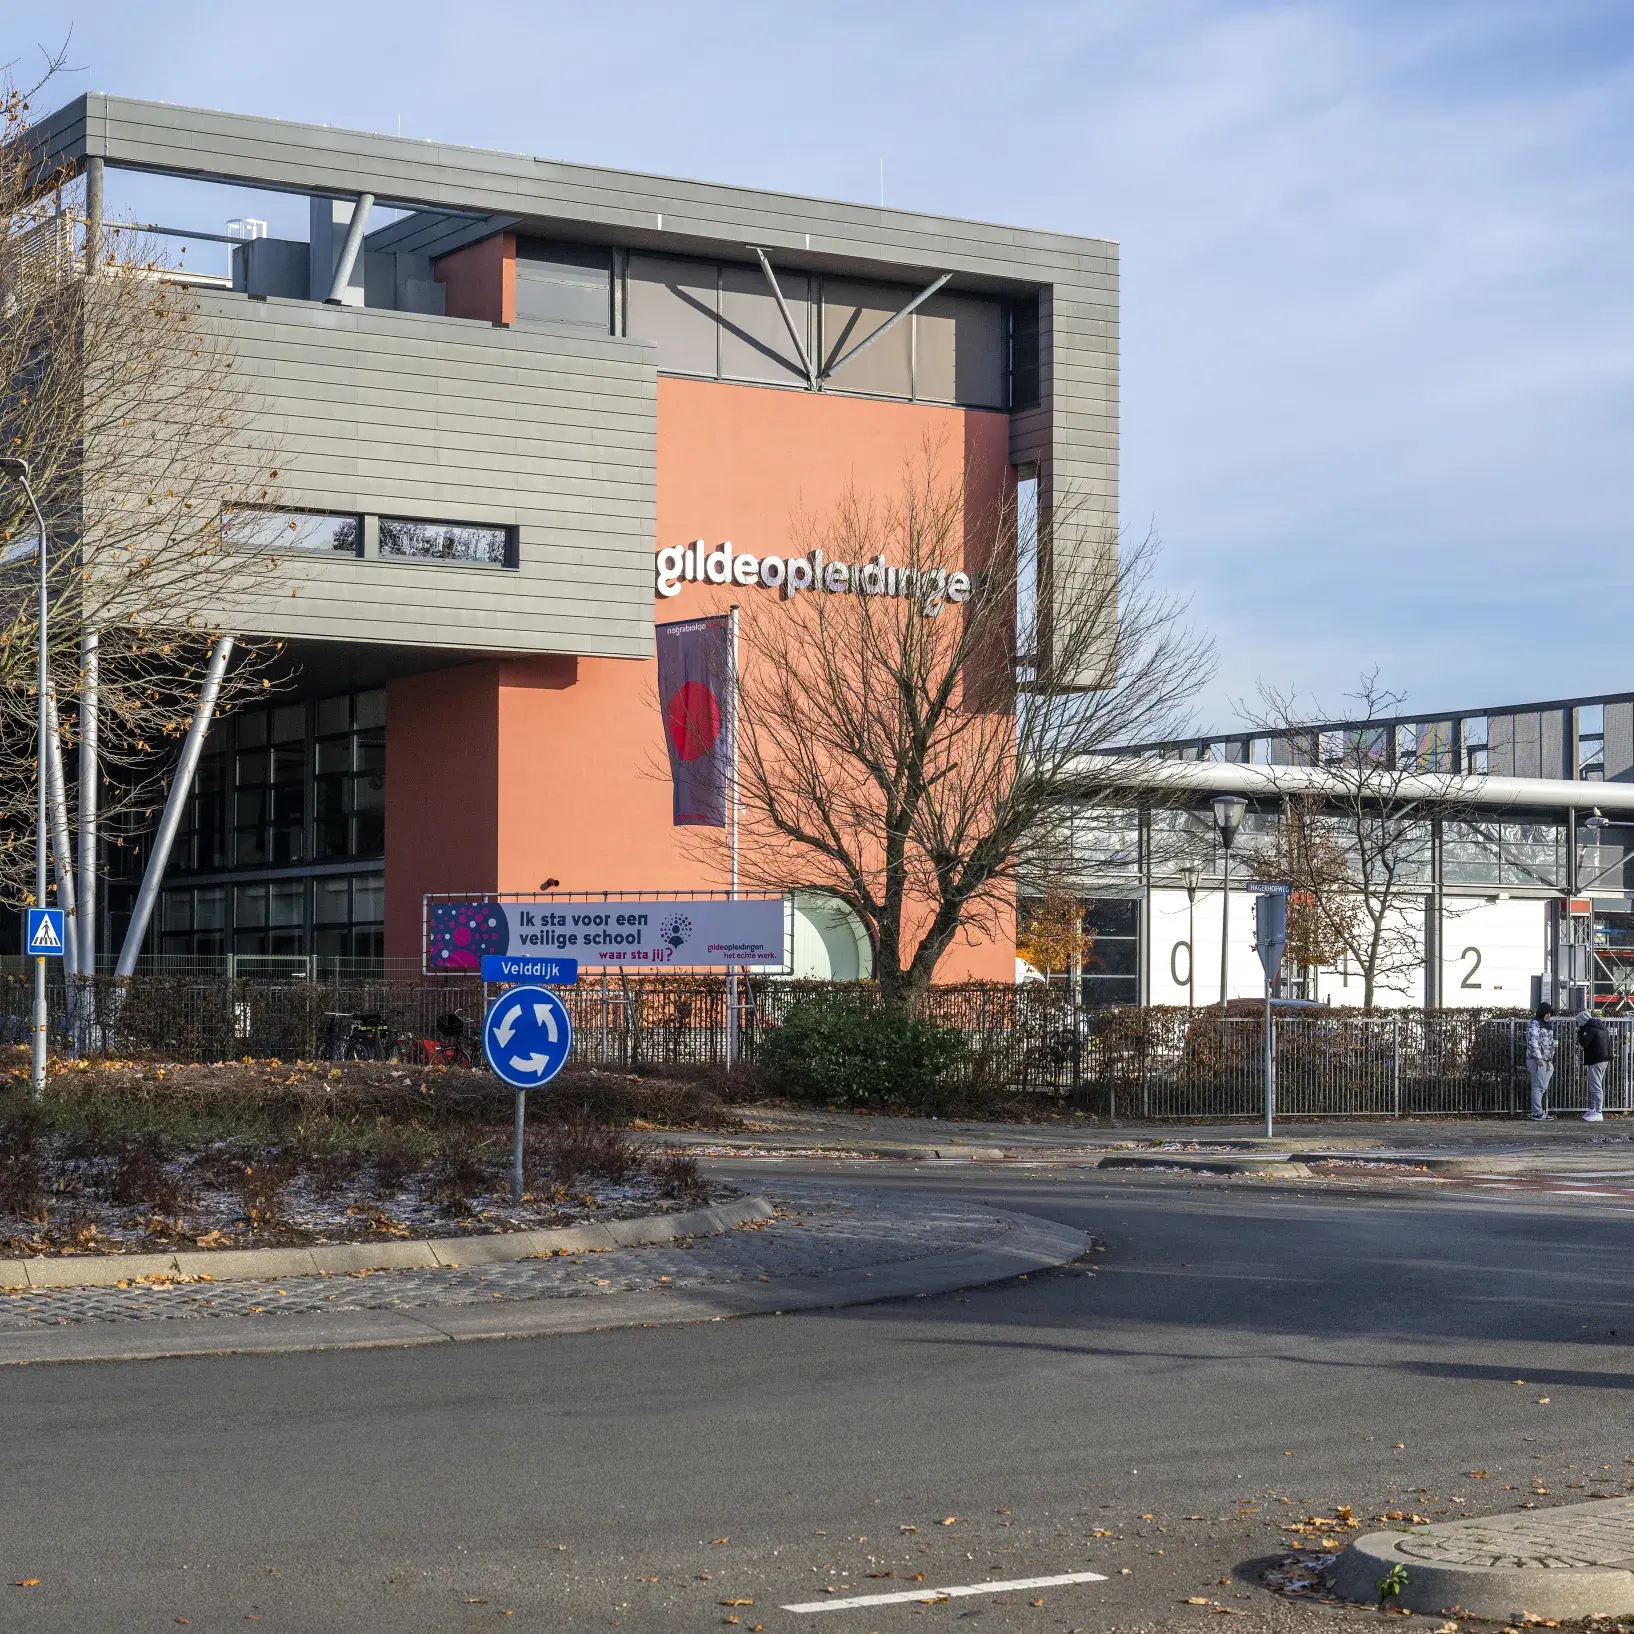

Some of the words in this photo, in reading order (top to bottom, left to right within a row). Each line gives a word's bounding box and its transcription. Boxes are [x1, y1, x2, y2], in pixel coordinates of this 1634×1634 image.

[656, 539, 990, 617] gildeopleidinge
[1250, 883, 1290, 893] HAGERHOFWEG
[519, 911, 535, 927] Ik
[540, 912, 566, 927] sta
[572, 914, 611, 927] voor
[615, 914, 648, 926] een
[519, 929, 578, 949] veilige
[583, 929, 642, 945] school
[598, 950, 627, 960] waar
[630, 950, 648, 960] sta
[651, 947, 673, 962] jij?
[707, 943, 764, 953] gildeopleidingen
[501, 961, 560, 980] Velddijk
[1460, 946, 1482, 989] 2
